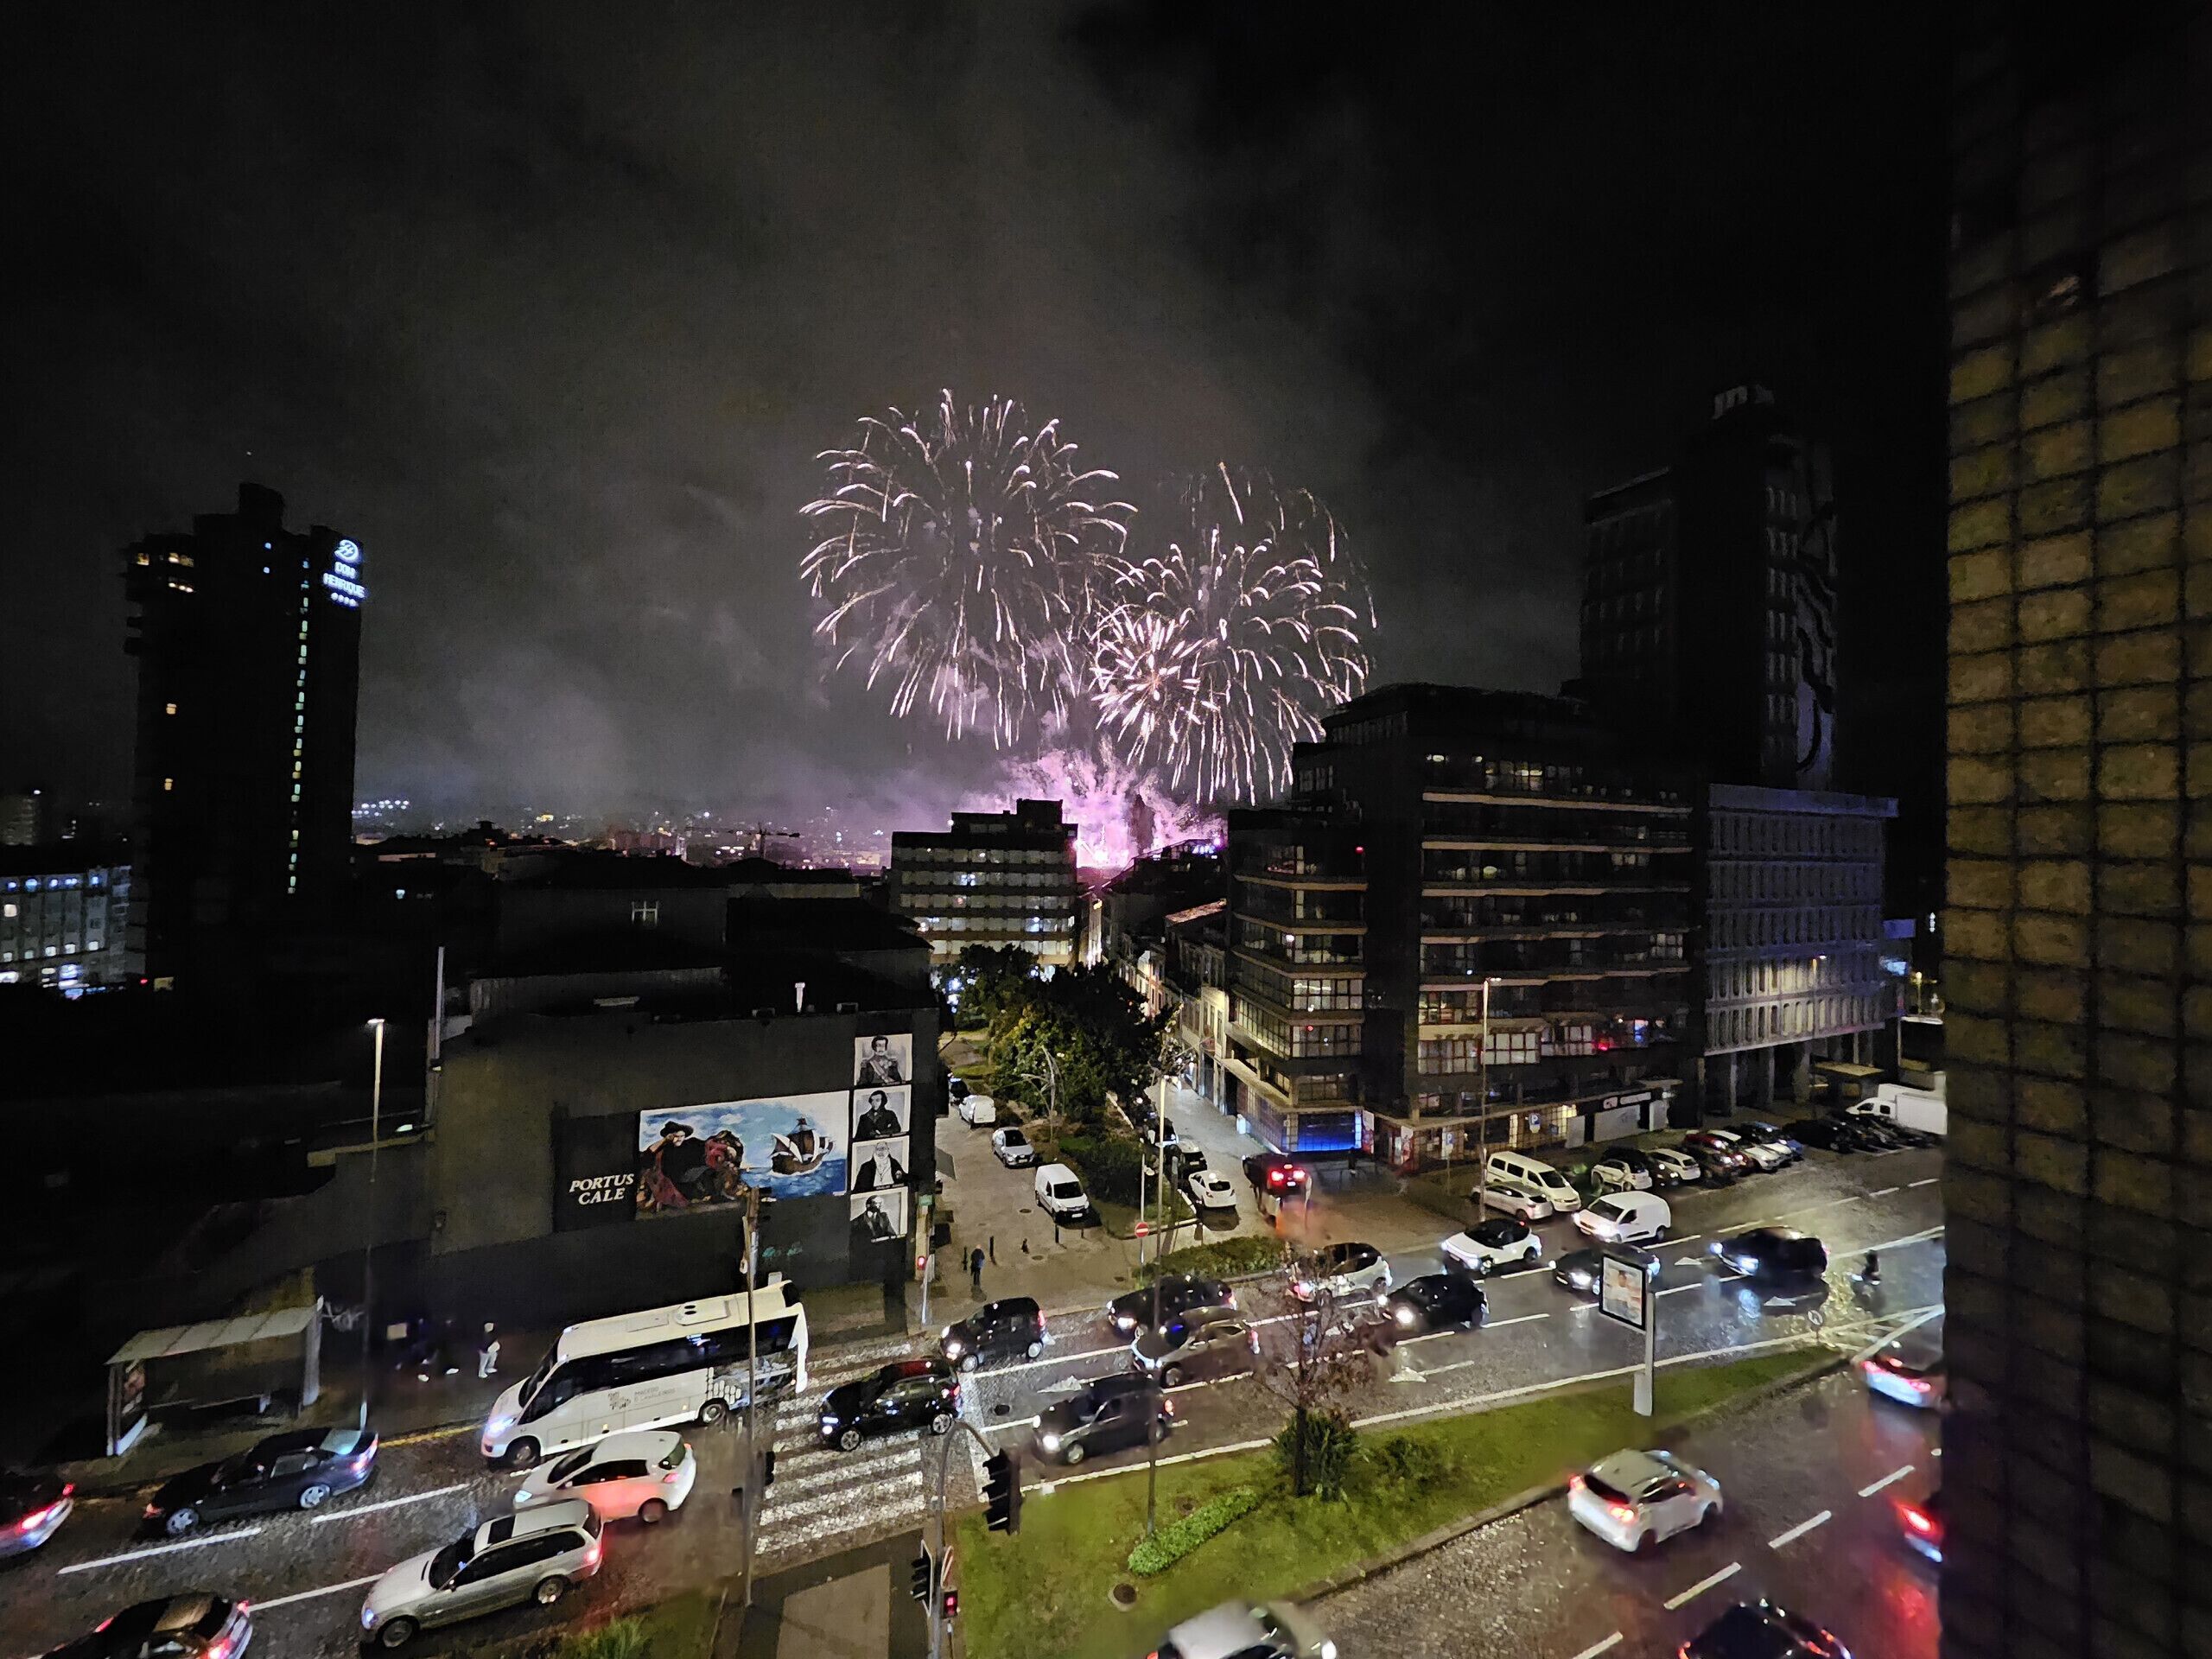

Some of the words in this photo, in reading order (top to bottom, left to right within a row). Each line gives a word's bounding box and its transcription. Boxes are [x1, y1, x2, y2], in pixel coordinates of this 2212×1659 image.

[323, 573, 365, 598] HENRIQUE
[569, 1173, 634, 1192] PORTUS
[578, 1187, 625, 1205] CALE
